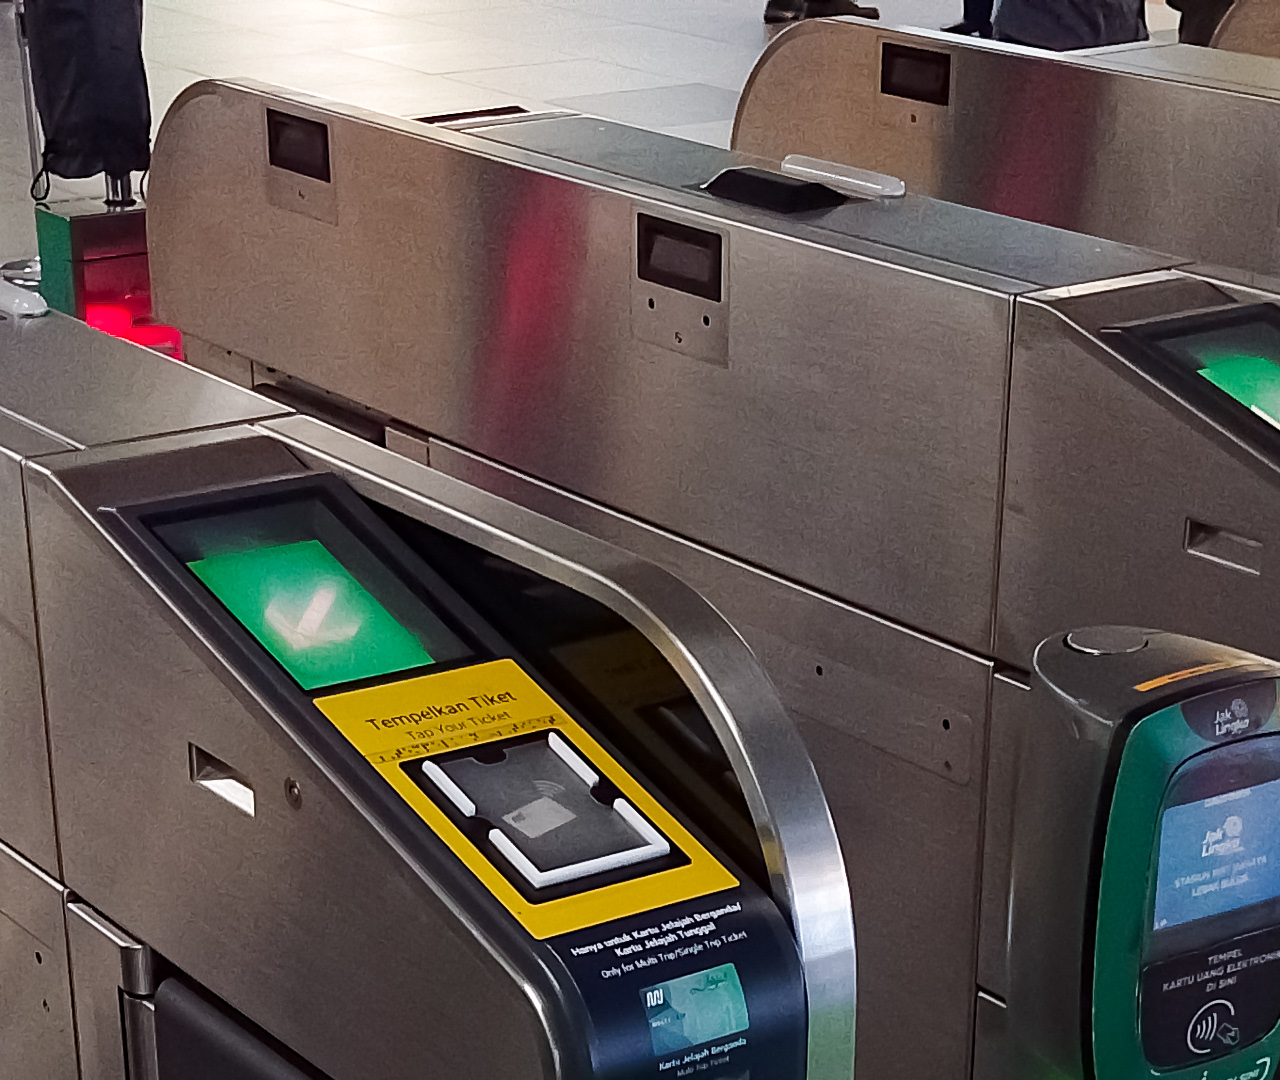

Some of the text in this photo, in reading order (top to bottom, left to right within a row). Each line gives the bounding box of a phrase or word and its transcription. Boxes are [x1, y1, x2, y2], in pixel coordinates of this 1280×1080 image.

[365, 691, 518, 731] Tempelkan Tiket
[405, 710, 513, 741] Tap Your Ticket
[570, 940, 604, 957] Hanya
[606, 933, 633, 948] untuk
[632, 926, 661, 940] Kartu
[661, 916, 695, 932] Jelajah
[614, 922, 717, 958] Kartu Jelajah Tunggal
[601, 967, 622, 979] Only
[622, 962, 635, 973] for
[635, 956, 659, 969] Multi
[704, 938, 722, 951] Trip
[722, 930, 748, 943] Ticket
[1208, 949, 1243, 965] TEMPEL
[1162, 975, 1195, 992] KARTU
[1196, 966, 1225, 982] UANG
[1205, 975, 1238, 993] DI SINI
[659, 1037, 747, 1071] Kartu Jelajah Berganda
